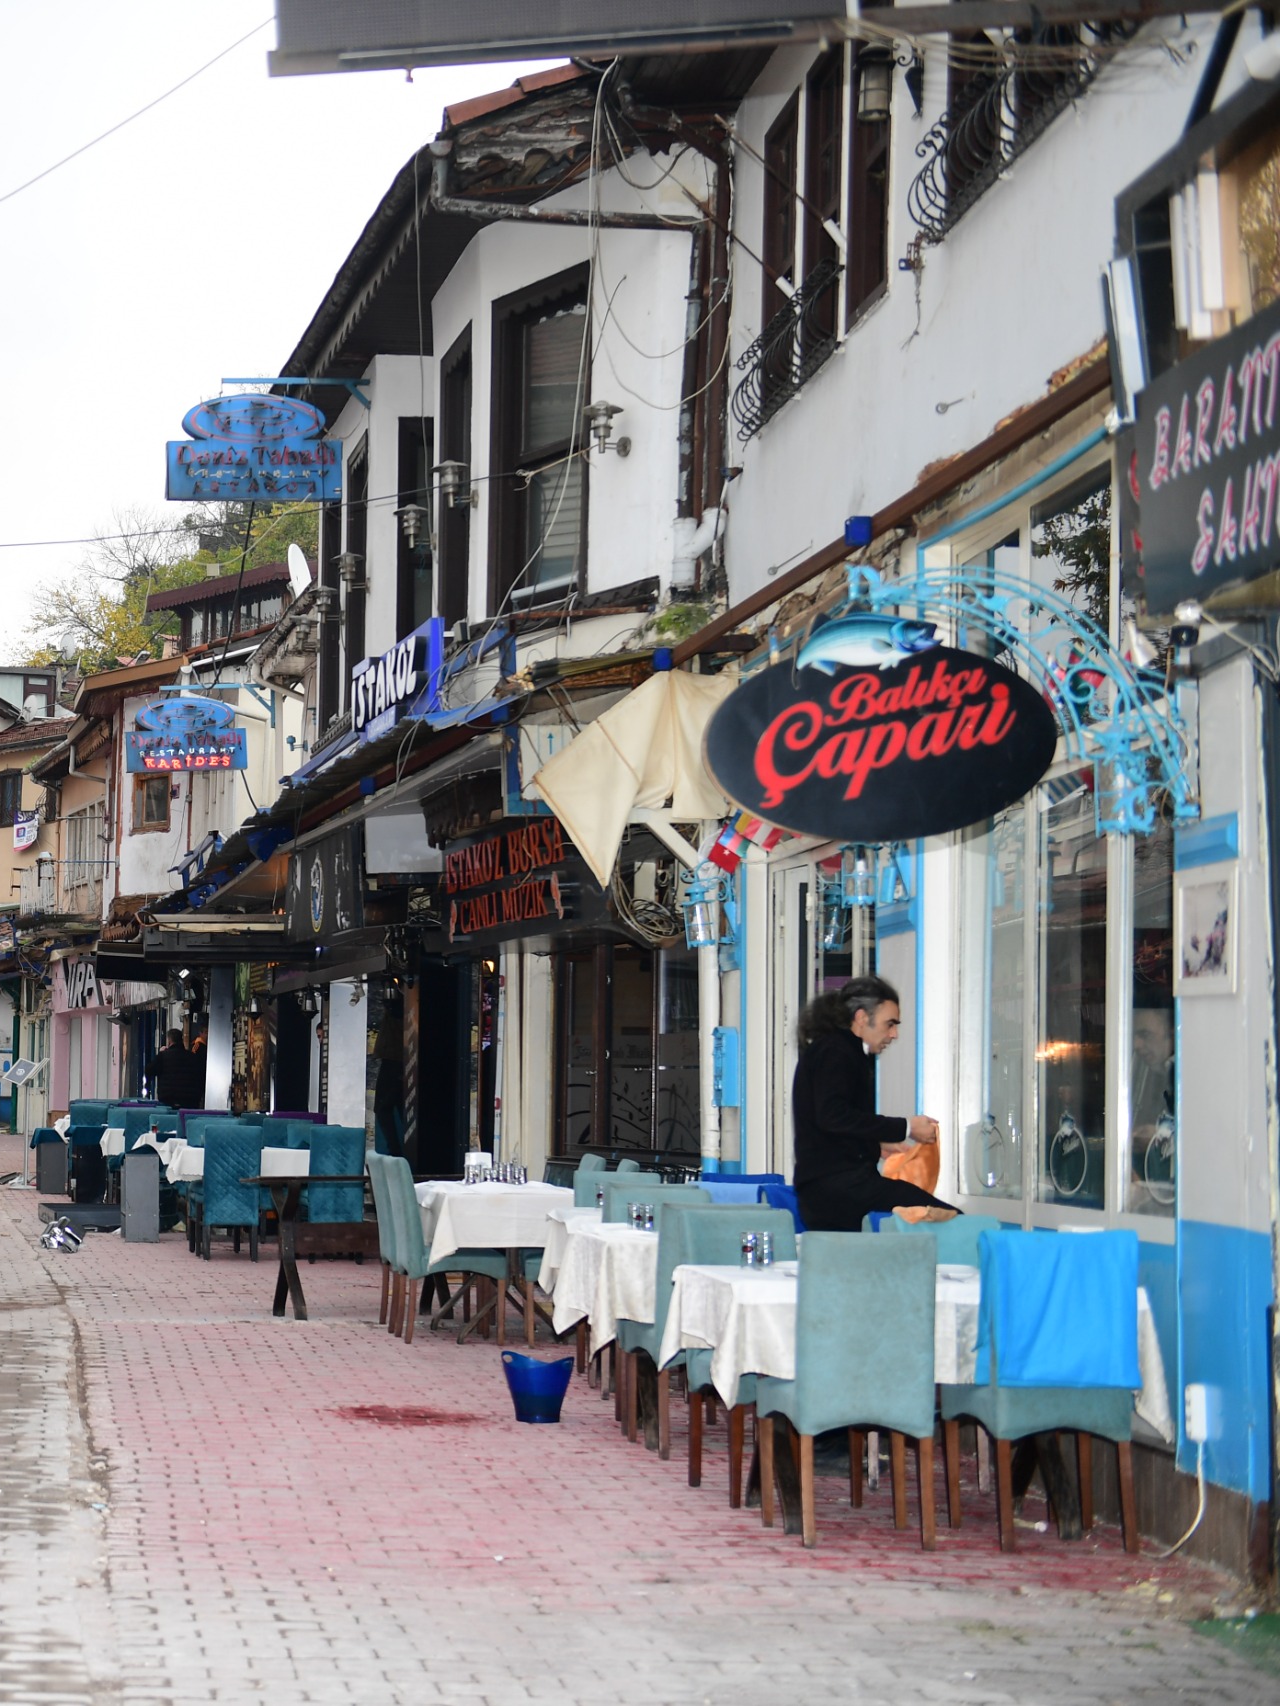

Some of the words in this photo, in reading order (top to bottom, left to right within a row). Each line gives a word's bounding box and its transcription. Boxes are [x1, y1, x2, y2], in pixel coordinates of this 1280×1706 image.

[823, 659, 988, 727] Balıkçı
[139, 746, 236, 758] RESTAURANT
[754, 682, 1017, 809] Çapari
[506, 816, 565, 875] BURSA
[460, 891, 498, 934] CANLI
[501, 876, 549, 923] MÜZİK
